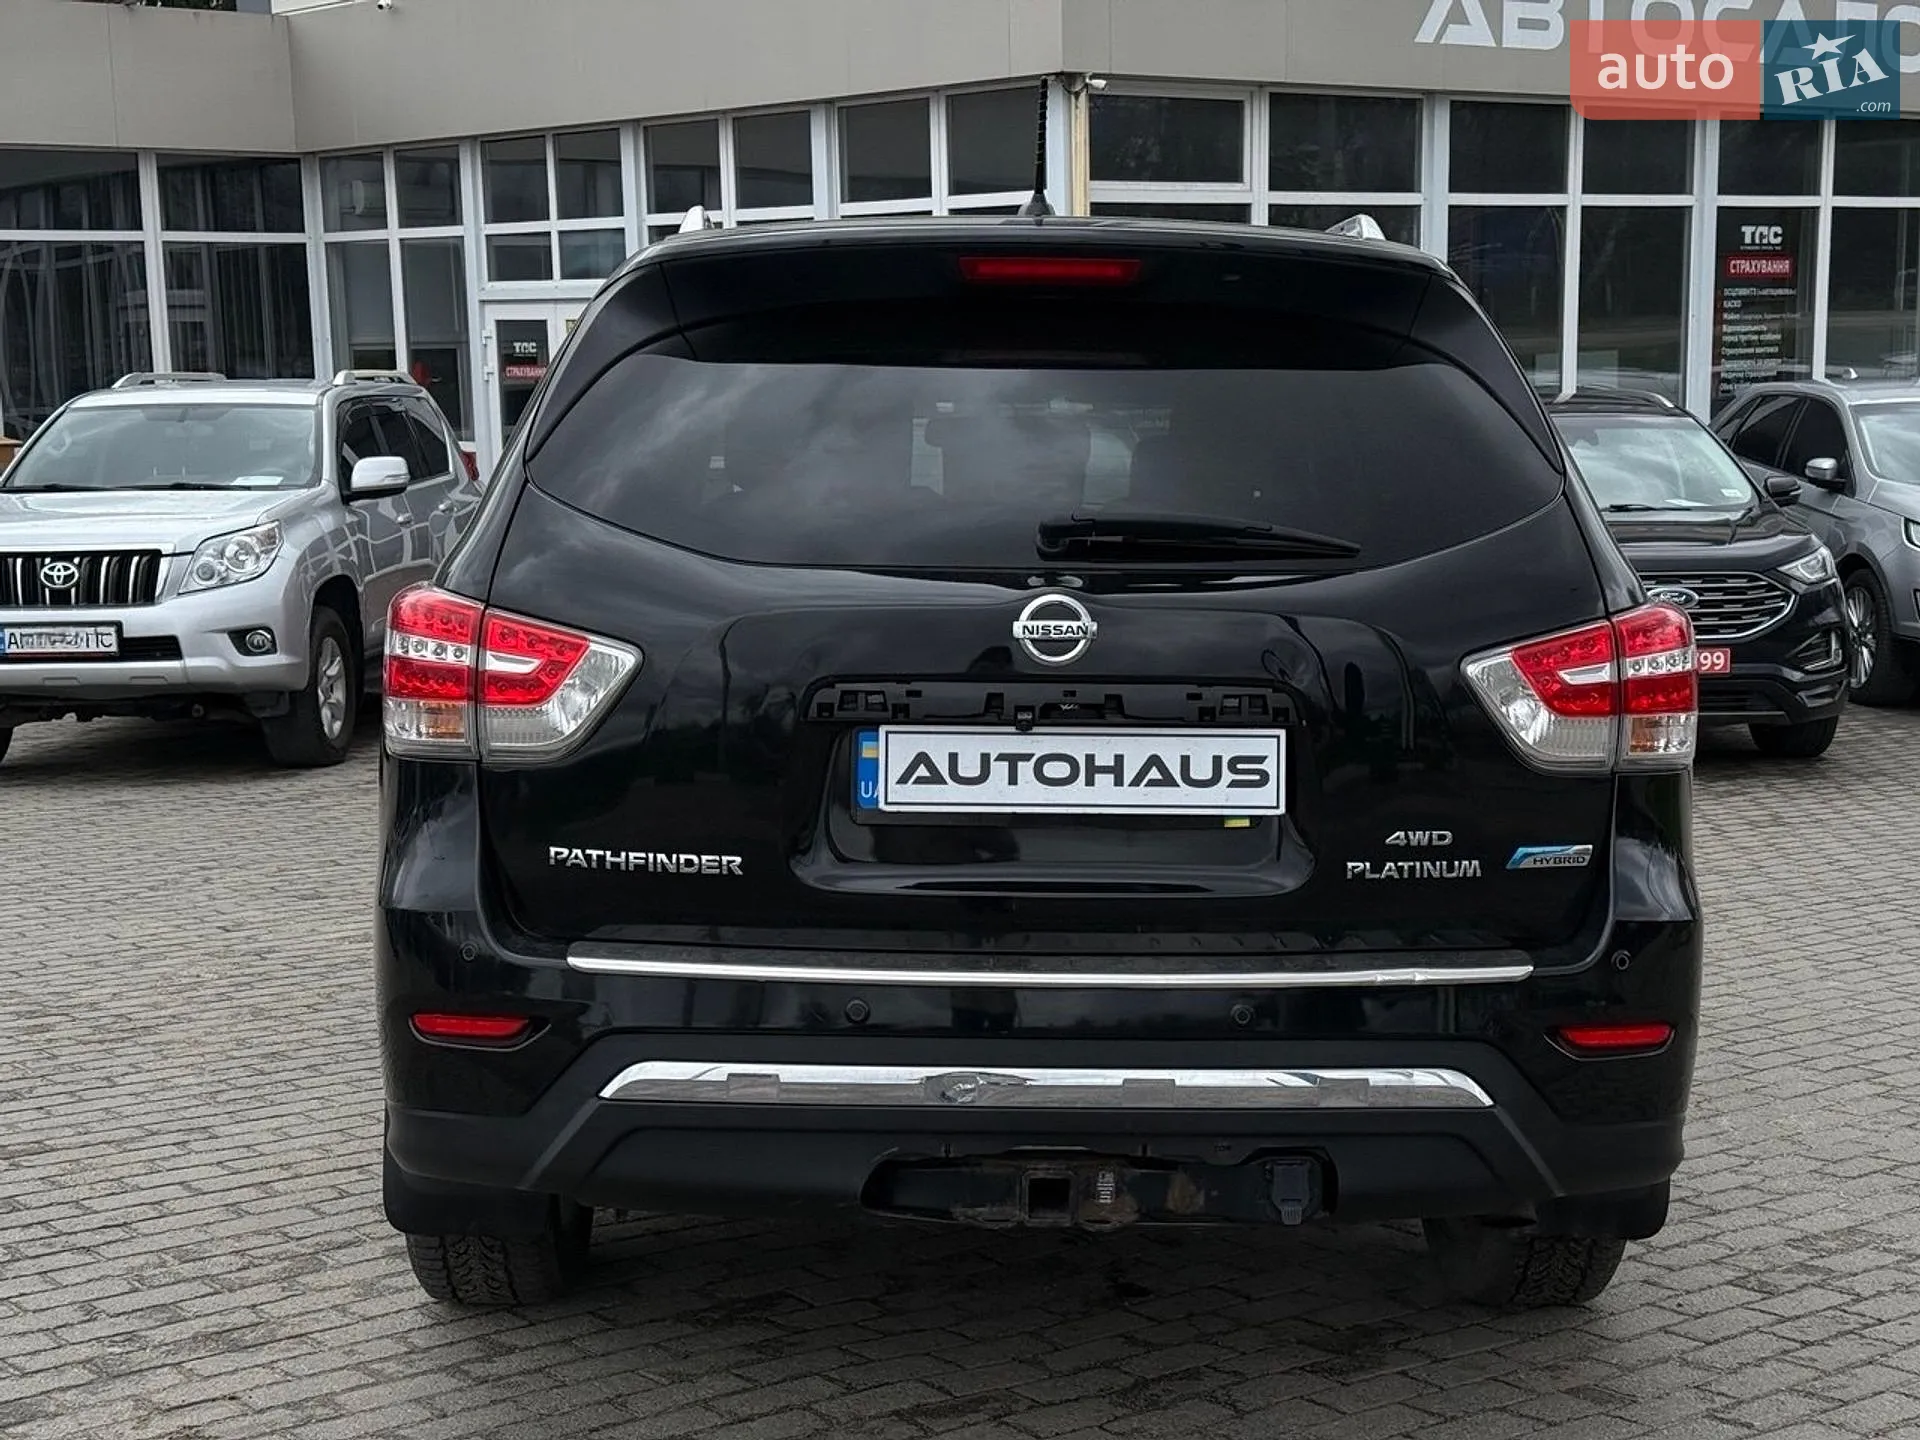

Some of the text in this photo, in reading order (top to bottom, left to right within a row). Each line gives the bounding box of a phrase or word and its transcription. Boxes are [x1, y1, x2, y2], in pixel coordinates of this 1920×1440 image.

[1729, 259, 1790, 274] СТРАХУВАННЯ
[1021, 623, 1089, 637] NISSAN
[1696, 651, 1725, 671] 99
[895, 751, 1271, 789] AUTOHAUS
[1384, 830, 1453, 847] 4WD
[548, 845, 744, 876] PATHFINDER
[1346, 859, 1482, 880] PLATINUM
[1532, 854, 1587, 867] HYBRID
